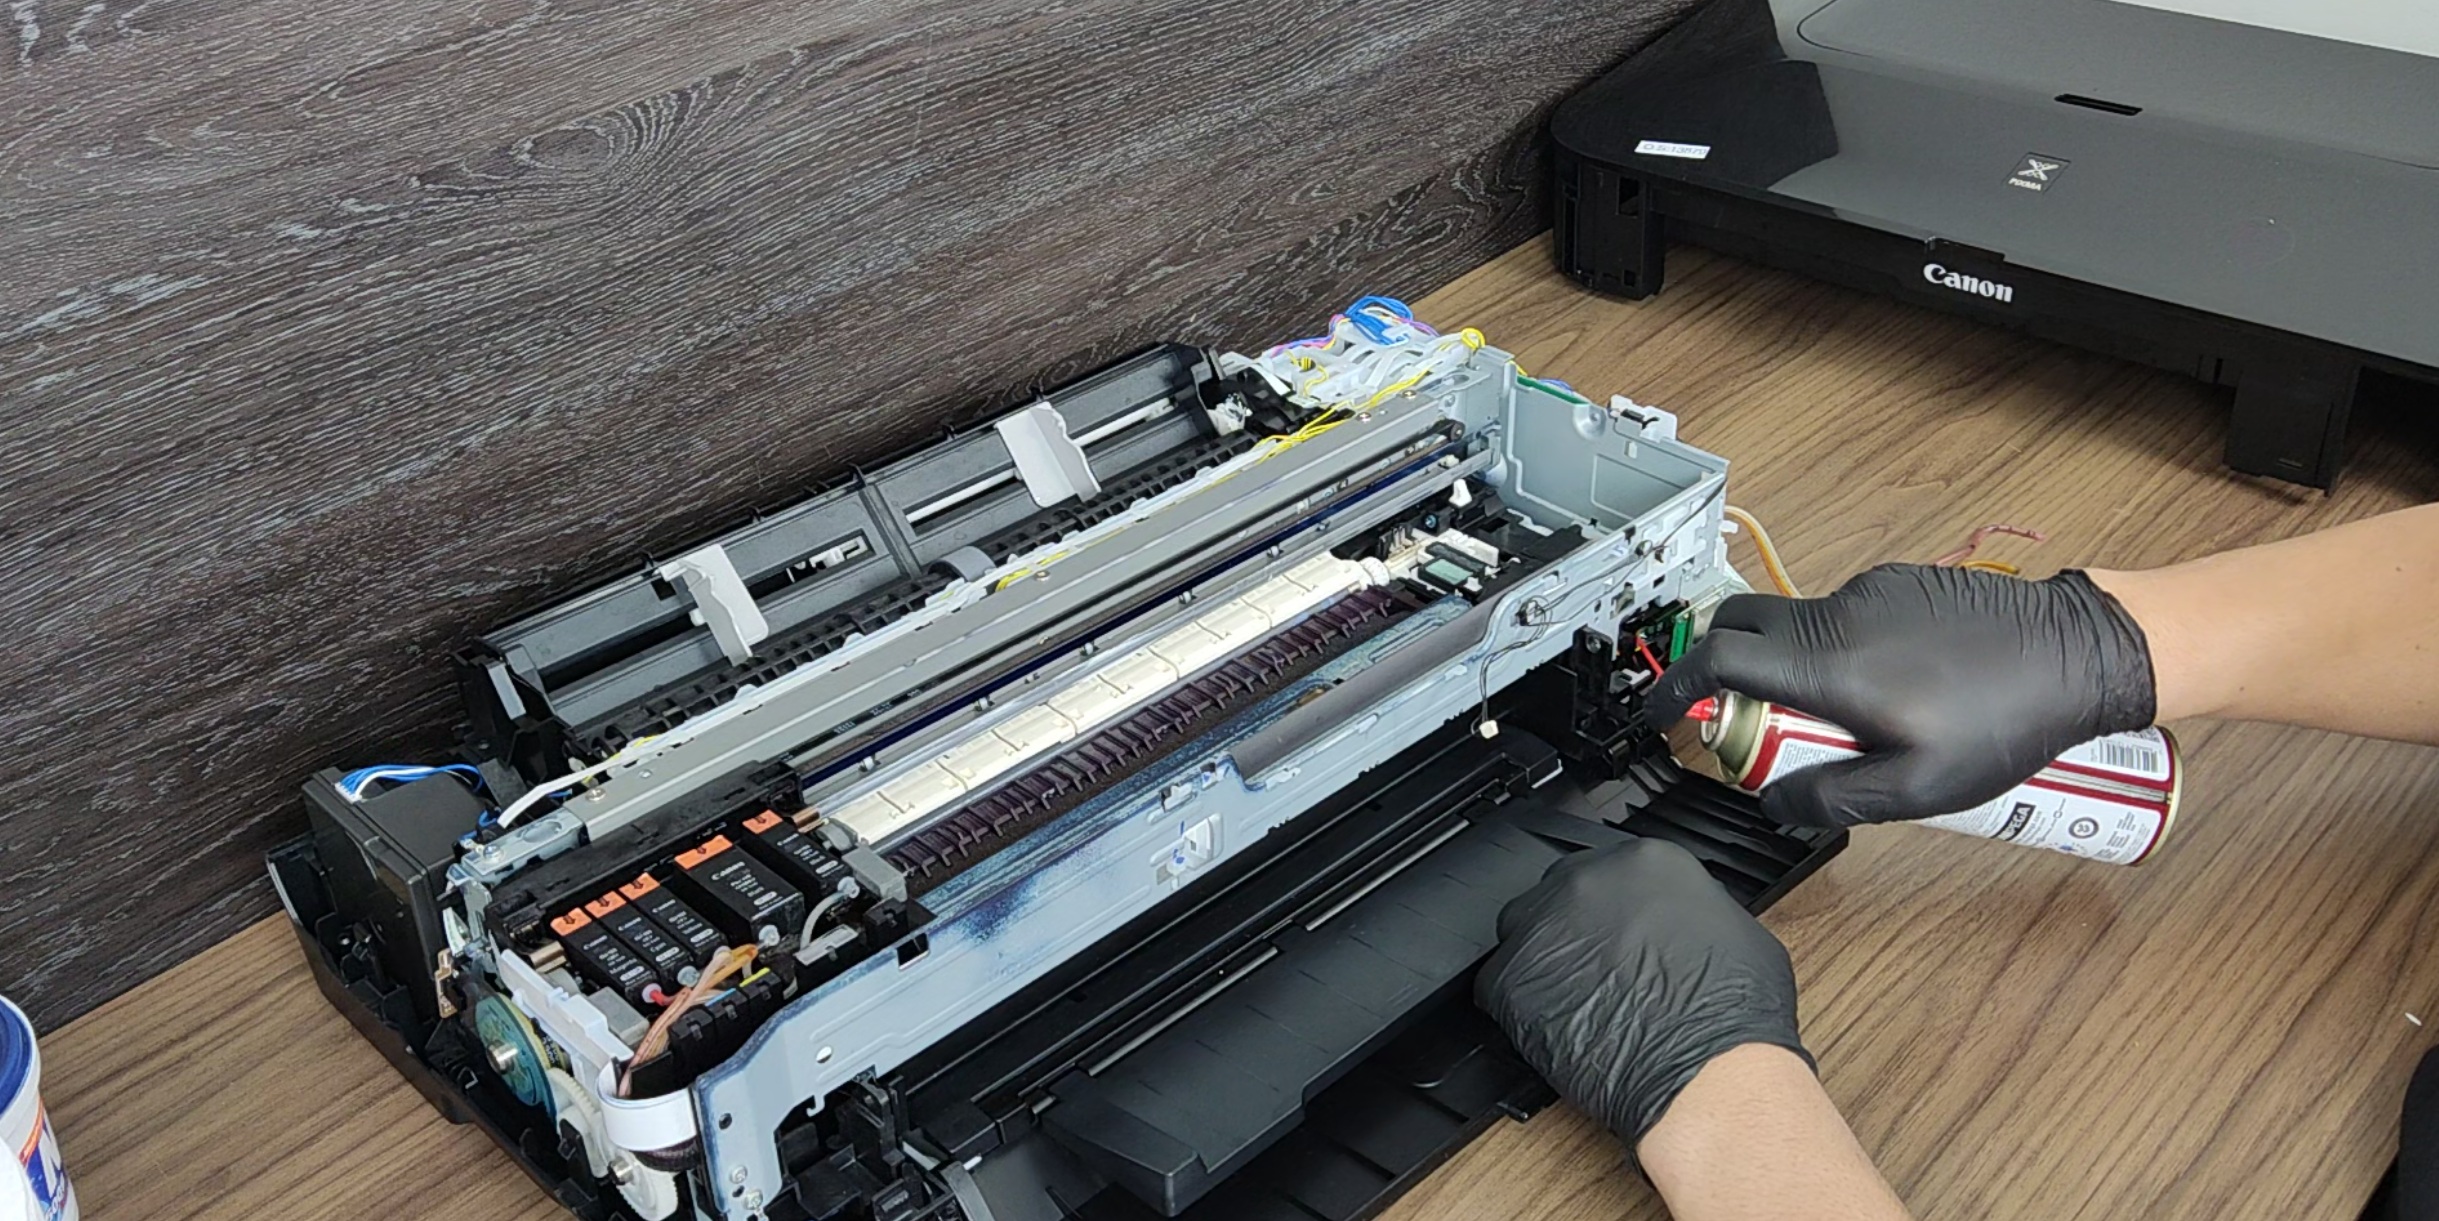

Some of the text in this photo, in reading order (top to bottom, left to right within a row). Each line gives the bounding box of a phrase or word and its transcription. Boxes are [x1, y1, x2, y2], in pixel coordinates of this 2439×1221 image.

[2008, 177, 2042, 191] PIXMA
[1923, 263, 2013, 302] Canon
[776, 833, 800, 846] Canon
[711, 861, 745, 881] Canon
[652, 899, 676, 913] Canon
[617, 916, 642, 931] Canon
[583, 935, 608, 950] Canon
